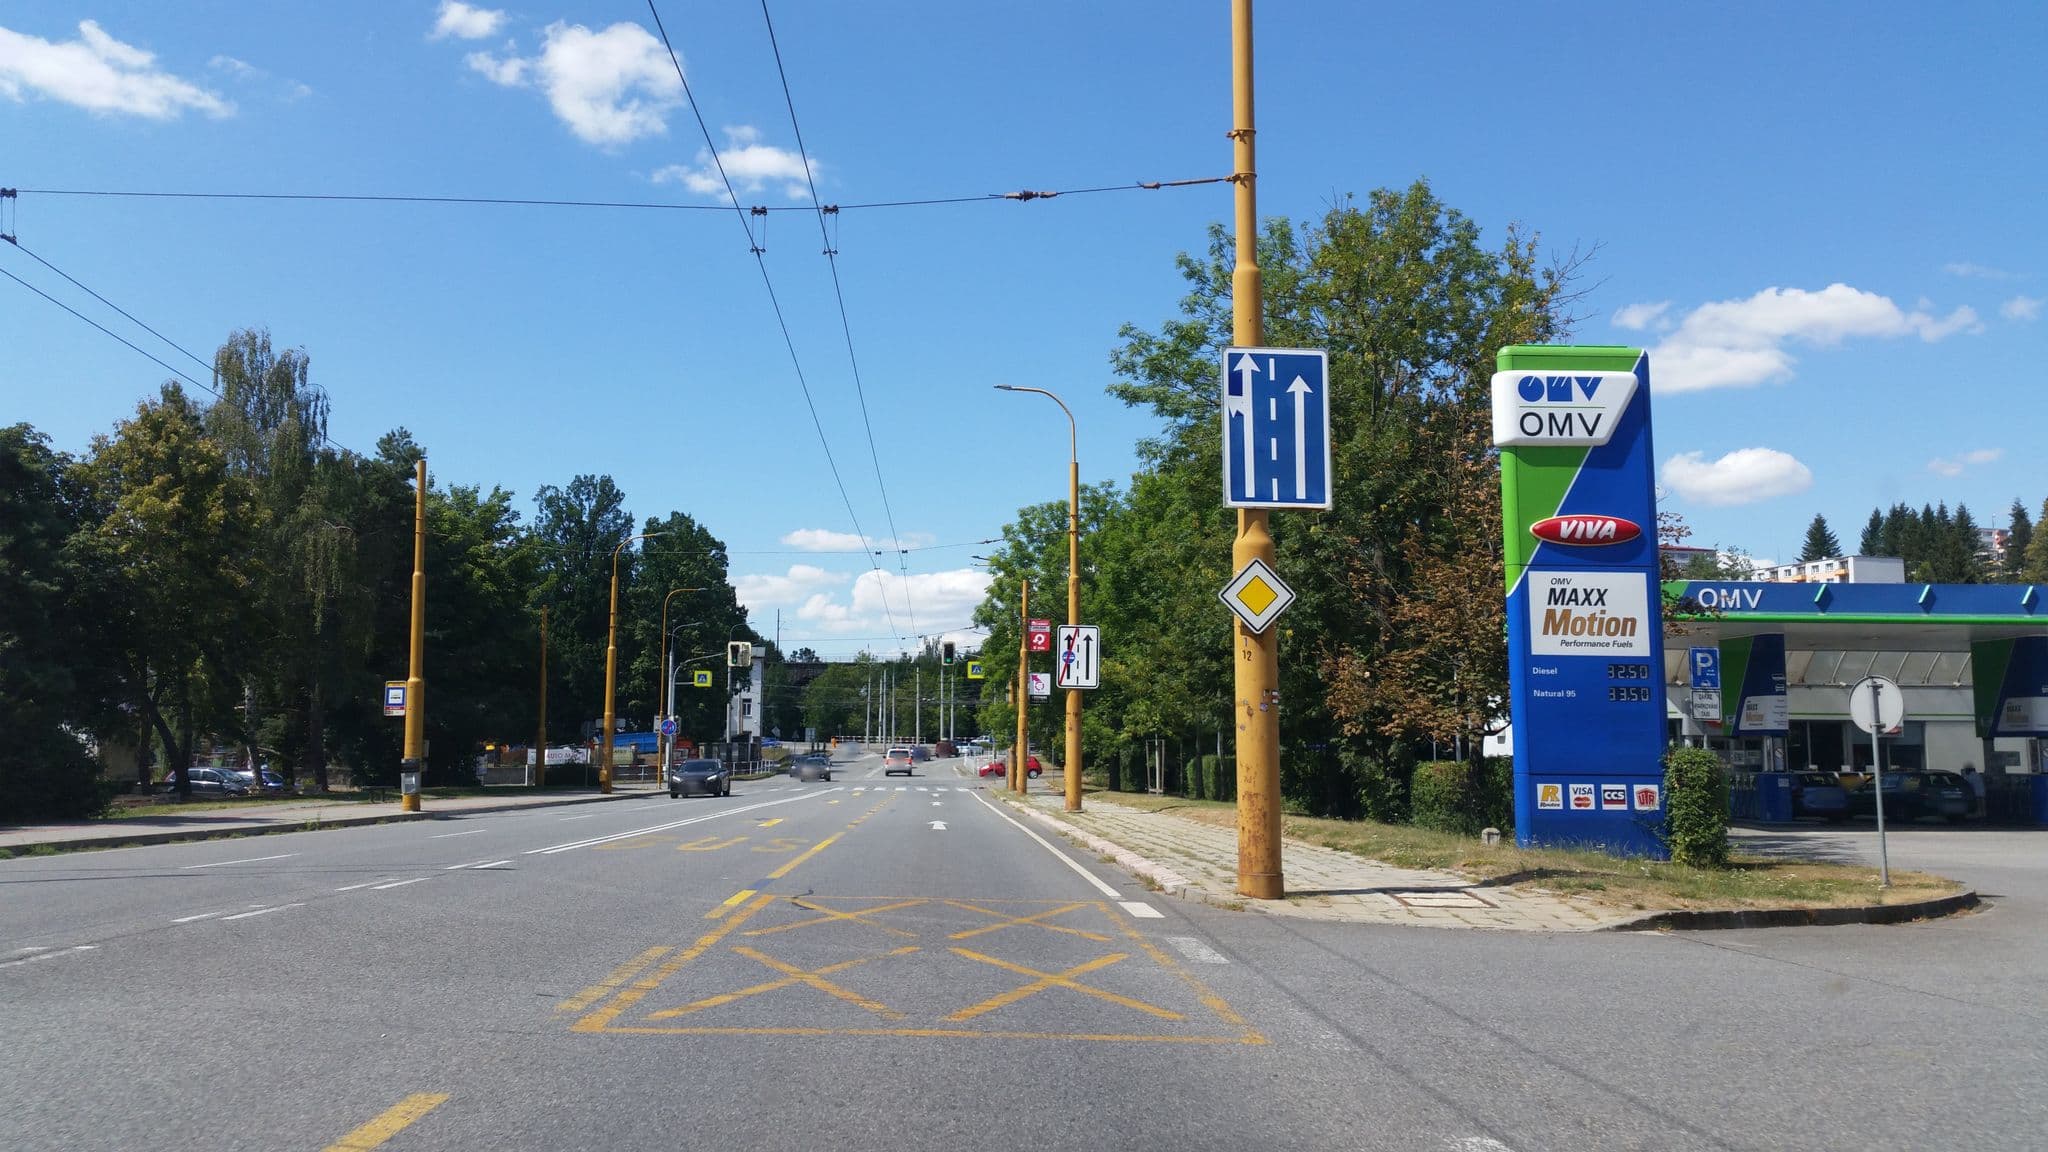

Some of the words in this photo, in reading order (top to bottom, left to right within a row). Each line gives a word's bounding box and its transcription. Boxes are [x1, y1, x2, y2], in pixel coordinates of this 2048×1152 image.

[1519, 412, 1602, 436] OMV
[1560, 519, 1617, 540] VIVA
[1550, 577, 1572, 585] OMV
[1547, 587, 1608, 606] MAXX
[1698, 588, 1763, 609] OMV
[1542, 608, 1637, 637] Motion
[1560, 639, 1611, 648] Performance
[1612, 640, 1633, 648] Fuels
[1242, 650, 1252, 661] 12
[1696, 652, 1713, 676] P
[1532, 666, 1558, 675] Diesel
[1533, 689, 1564, 697] Natural
[1566, 690, 1576, 698] 95
[1572, 787, 1593, 795] VISA
[1604, 791, 1625, 800] CCS
